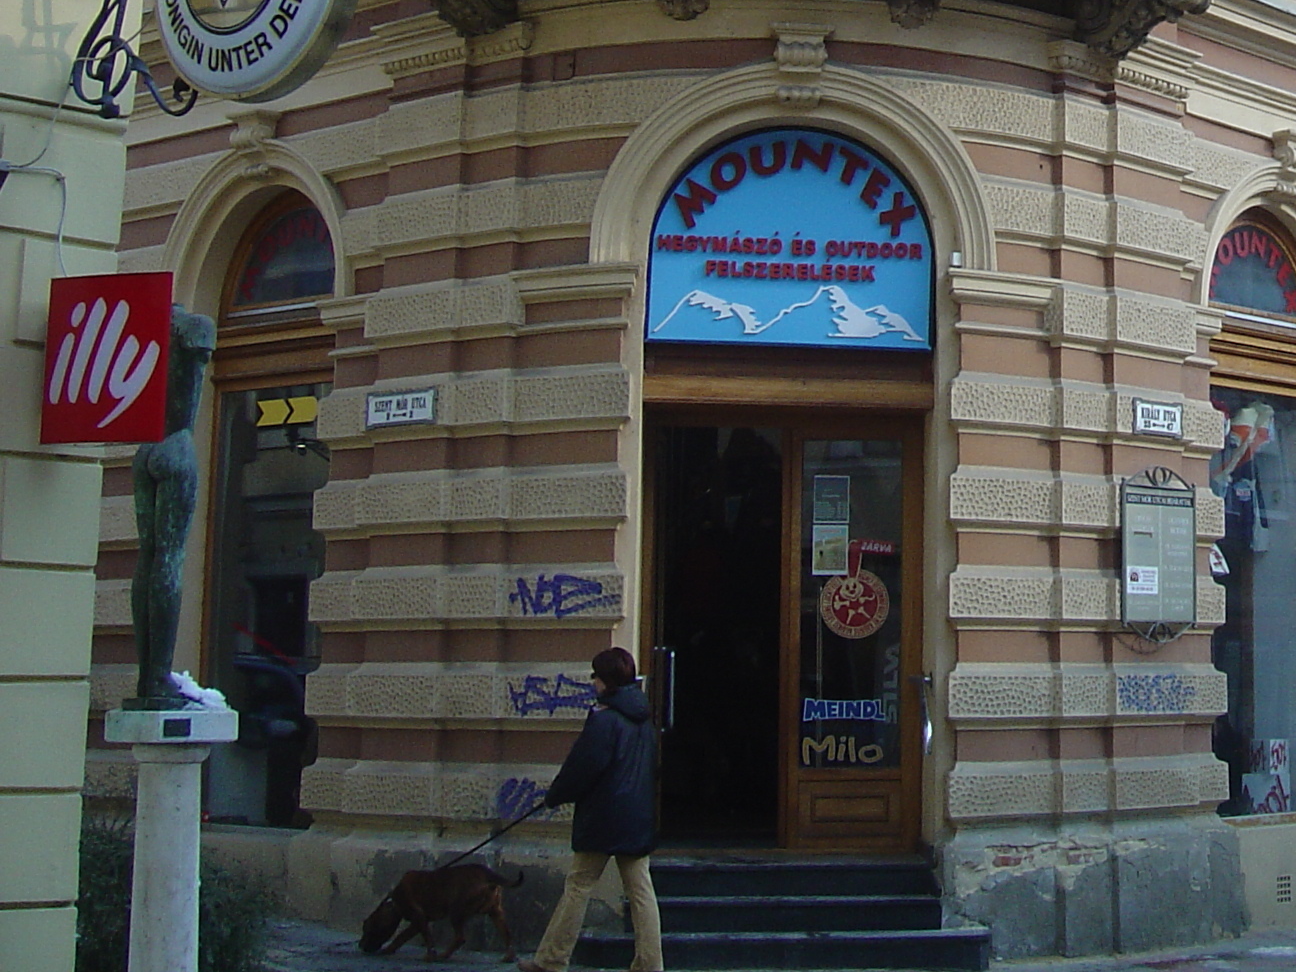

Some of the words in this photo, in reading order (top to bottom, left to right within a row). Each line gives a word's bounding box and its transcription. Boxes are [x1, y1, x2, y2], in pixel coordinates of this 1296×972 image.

[208, 32, 273, 73] UNTER
[674, 138, 917, 238] MOUNTEX
[657, 230, 783, 255] HEGYMÁSZÓ
[792, 231, 817, 256] ÉS
[825, 240, 923, 260] OUTDOOR
[705, 257, 876, 282] FELSZERELÉSEK
[50, 297, 161, 428] illy
[1163, 409, 1177, 423] UTCA
[803, 698, 886, 722] MEINDL
[802, 735, 884, 765] Milo
